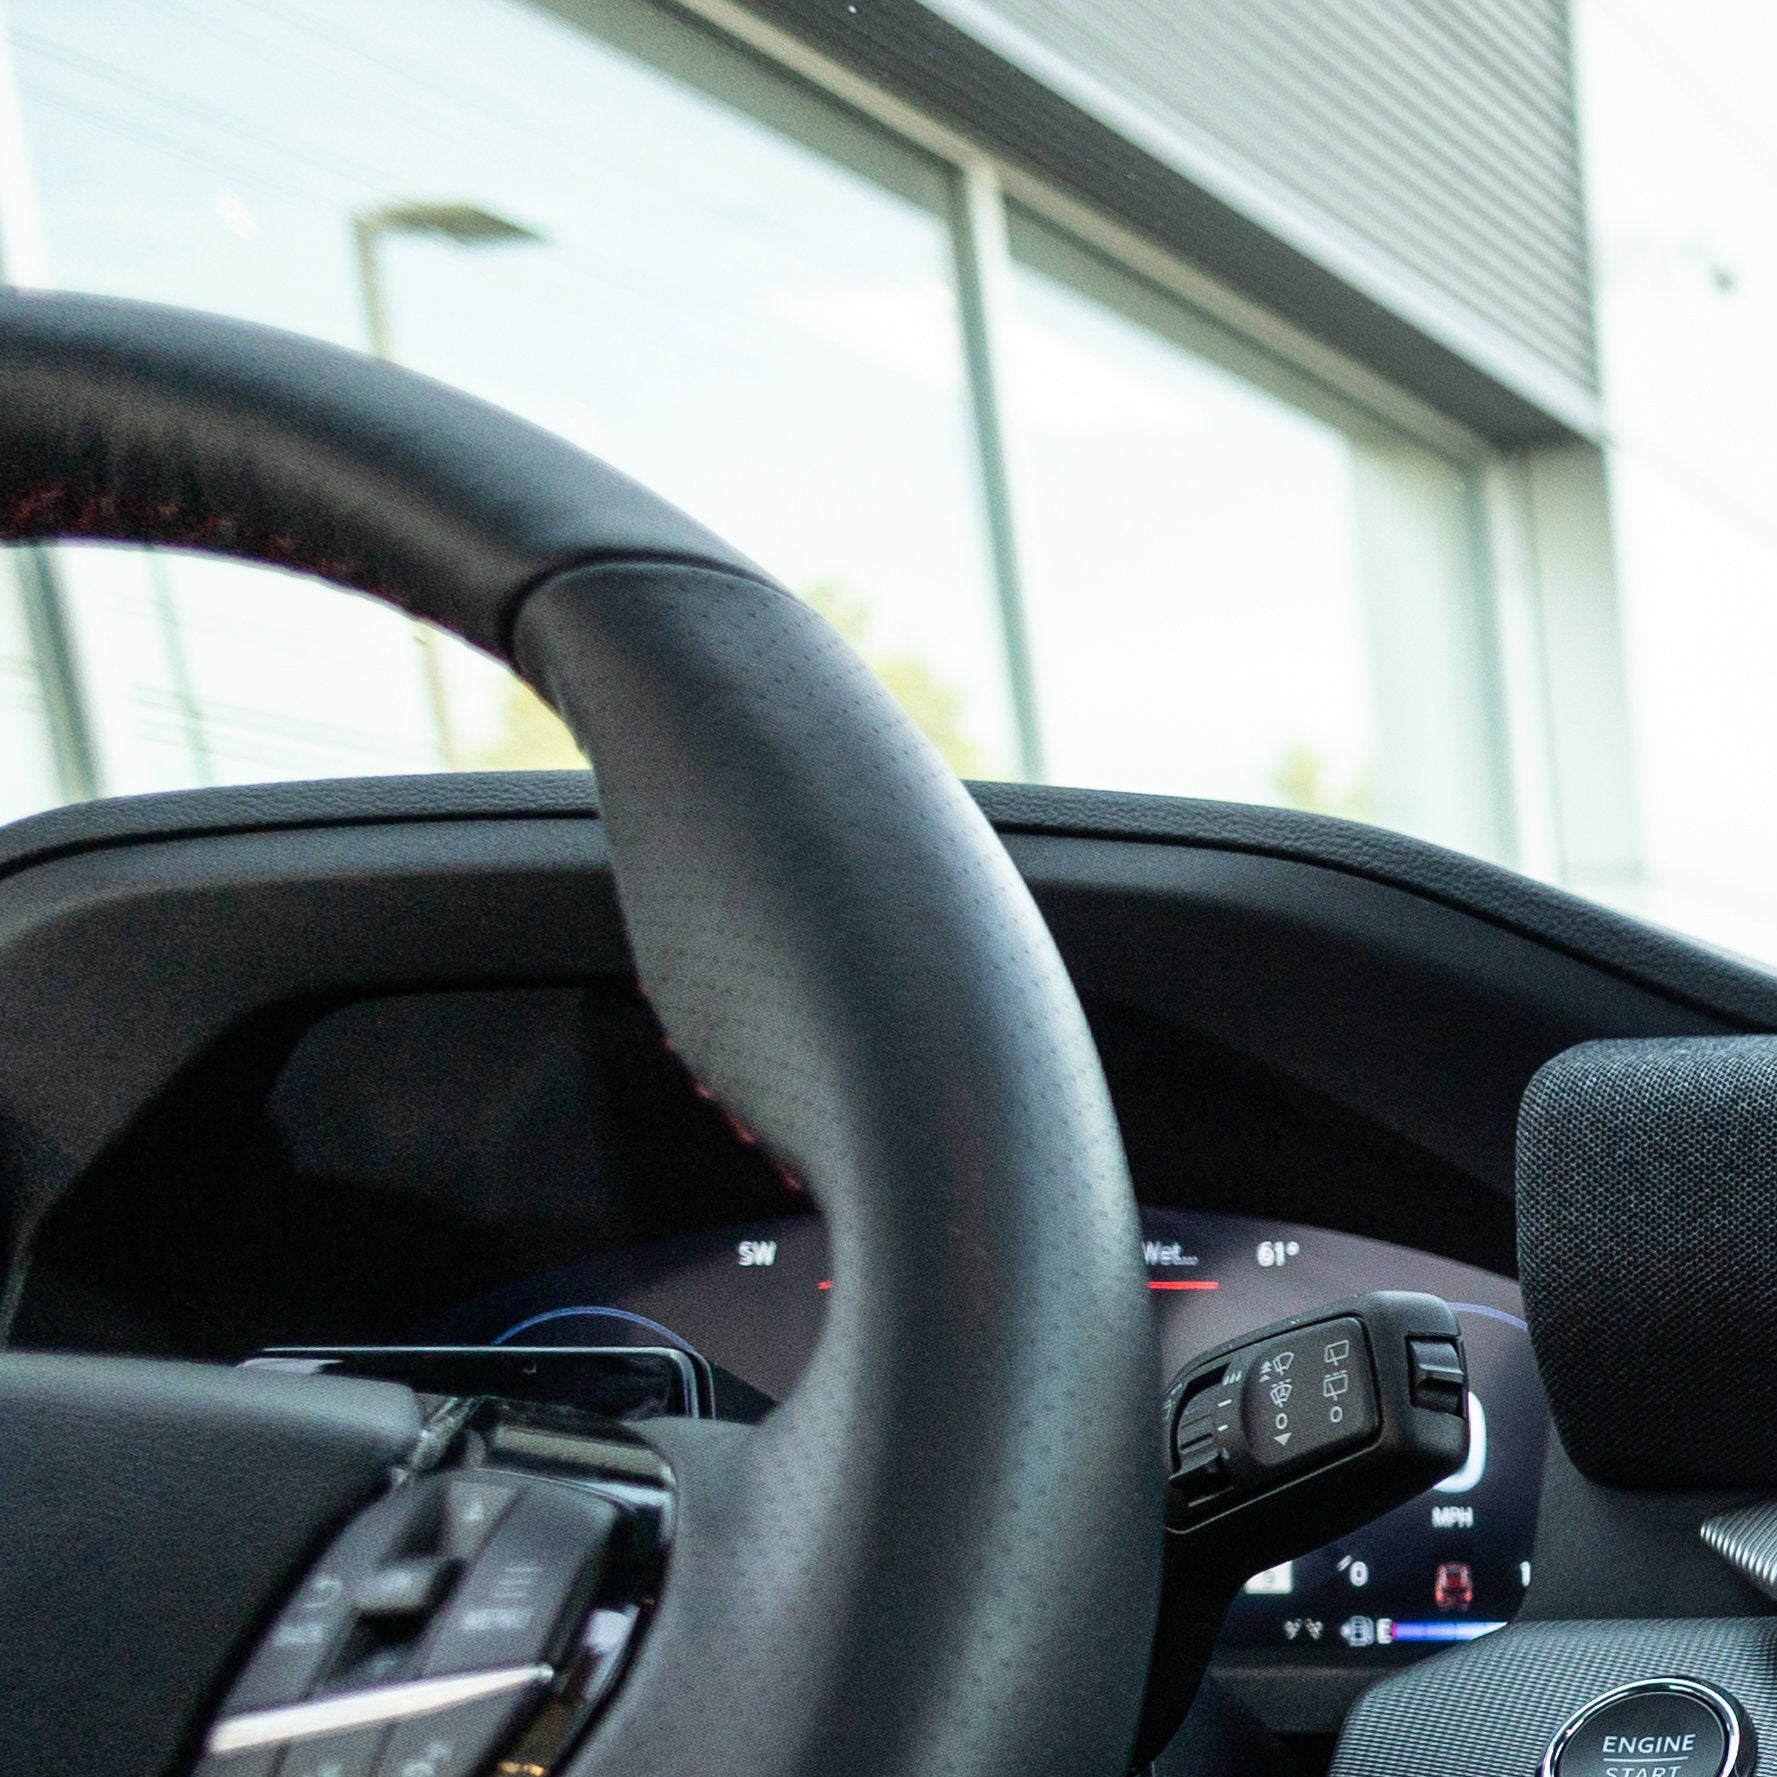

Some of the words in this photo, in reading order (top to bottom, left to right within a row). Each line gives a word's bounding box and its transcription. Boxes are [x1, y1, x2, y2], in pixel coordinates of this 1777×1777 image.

[737, 1240, 777, 1266] SW
[1431, 1506, 1474, 1528] MPH
[1376, 1618, 1393, 1645] E
[1602, 1733, 1696, 1753] ENGINE
